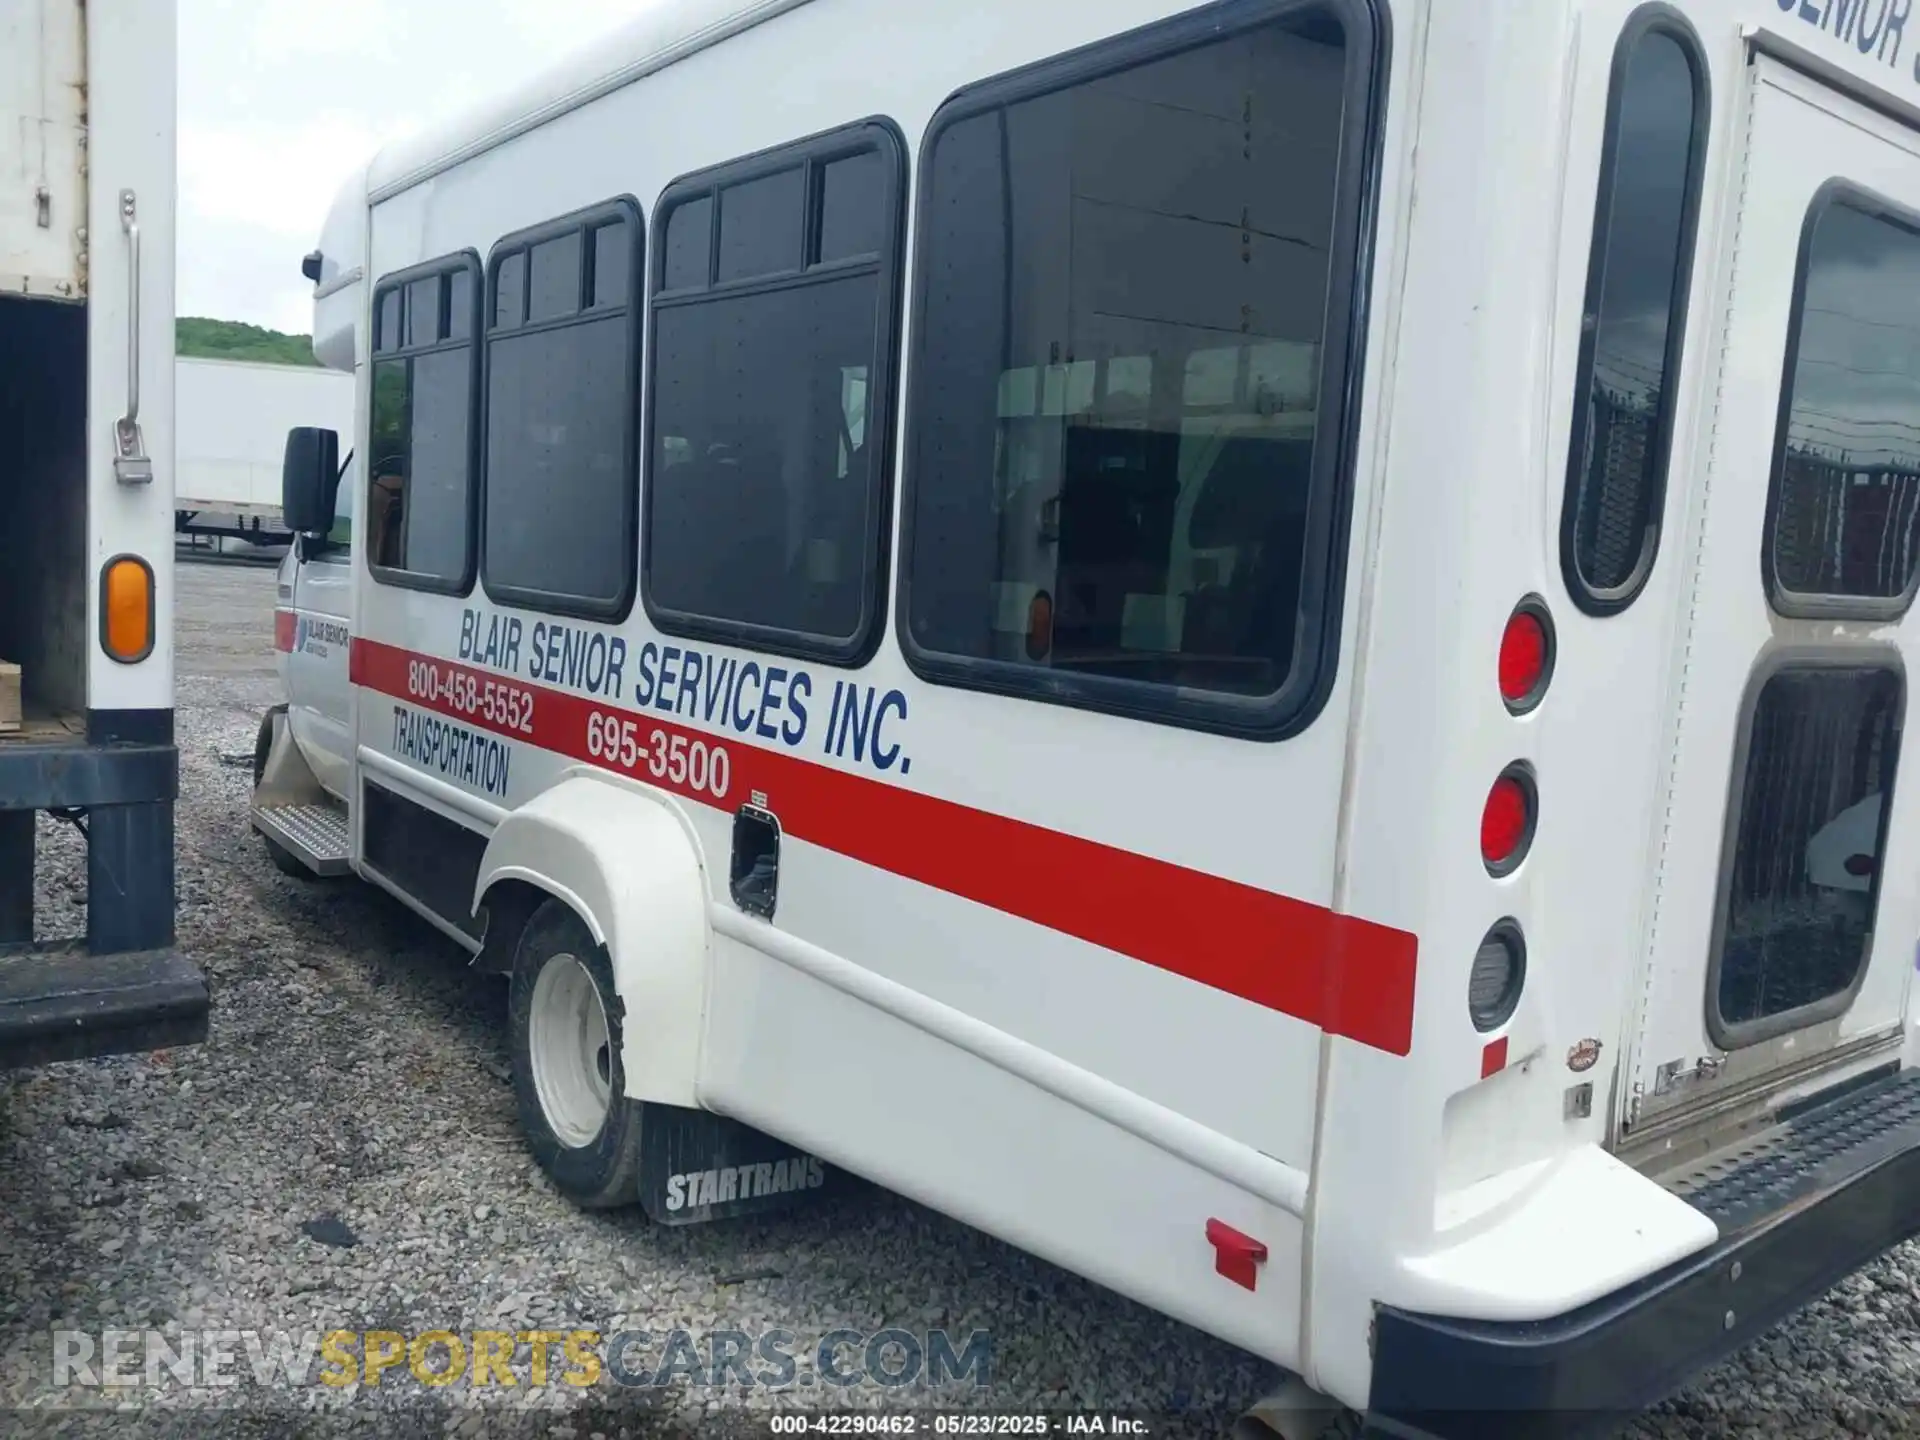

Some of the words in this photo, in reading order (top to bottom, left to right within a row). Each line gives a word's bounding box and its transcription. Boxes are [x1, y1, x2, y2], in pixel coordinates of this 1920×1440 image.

[408, 659, 534, 734] 800-458-5552
[459, 609, 522, 673] BLAIR
[529, 621, 626, 699] SENIOR
[635, 642, 812, 746] SERVICES
[824, 680, 911, 774] INC.
[393, 705, 511, 797] TRANSPORTATION
[587, 711, 730, 798] 695-3500
[666, 1157, 825, 1211] STARTRANS
